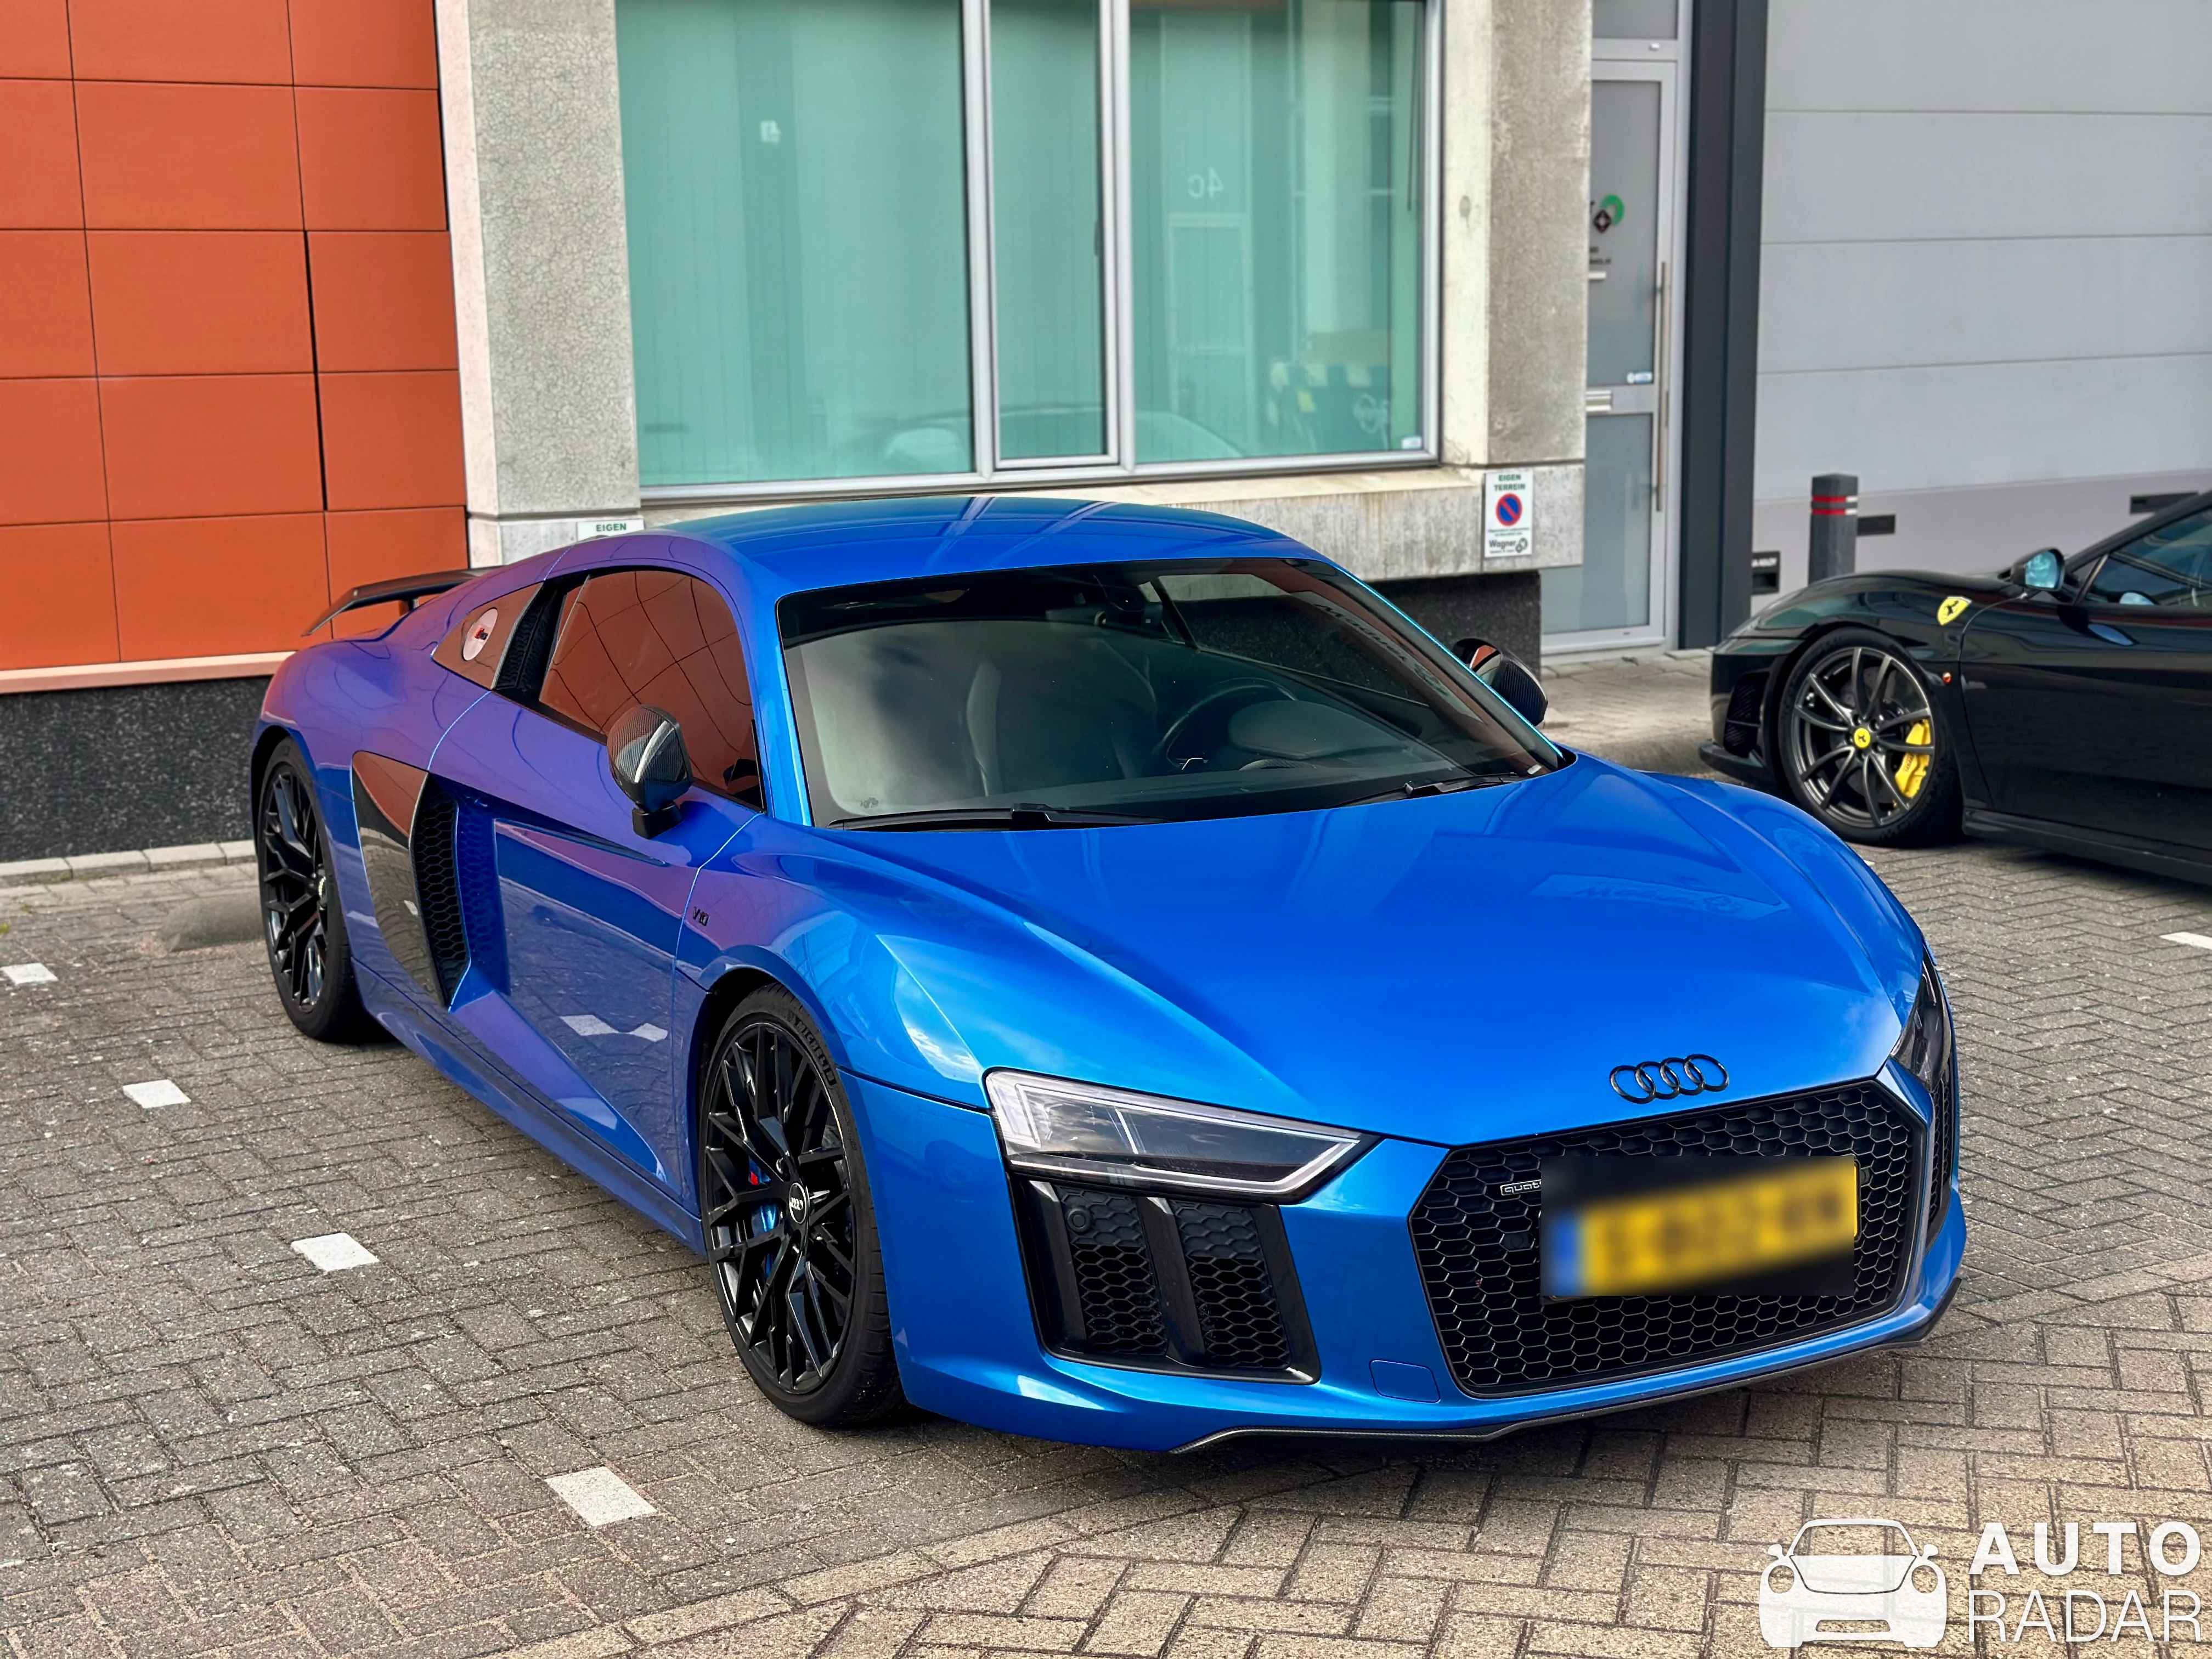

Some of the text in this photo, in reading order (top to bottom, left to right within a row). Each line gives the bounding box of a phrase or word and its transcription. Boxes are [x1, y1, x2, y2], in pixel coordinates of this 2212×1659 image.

[1494, 483, 1526, 492] TERREIN
[596, 523, 627, 532] EIGEN
[1489, 540, 1516, 550] Wagner
[1504, 1181, 1541, 1194] quat
